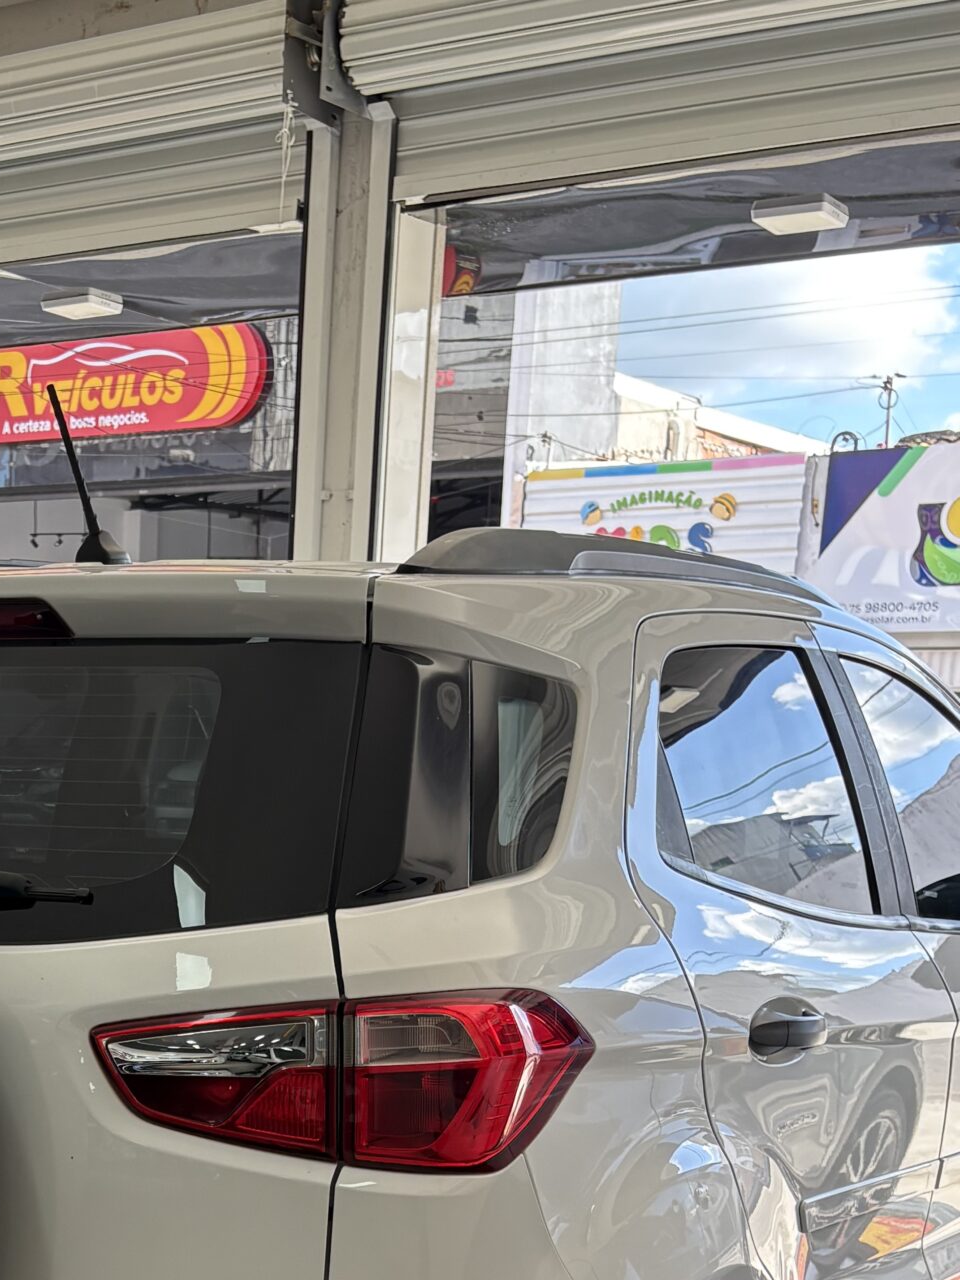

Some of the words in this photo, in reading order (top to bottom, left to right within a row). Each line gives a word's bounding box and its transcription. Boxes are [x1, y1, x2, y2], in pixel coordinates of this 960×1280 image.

[32, 369, 186, 416] VEÍCULOS
[2, 420, 12, 435] A
[12, 419, 51, 434] certeza
[610, 490, 703, 513] IMAGINAÇÃO
